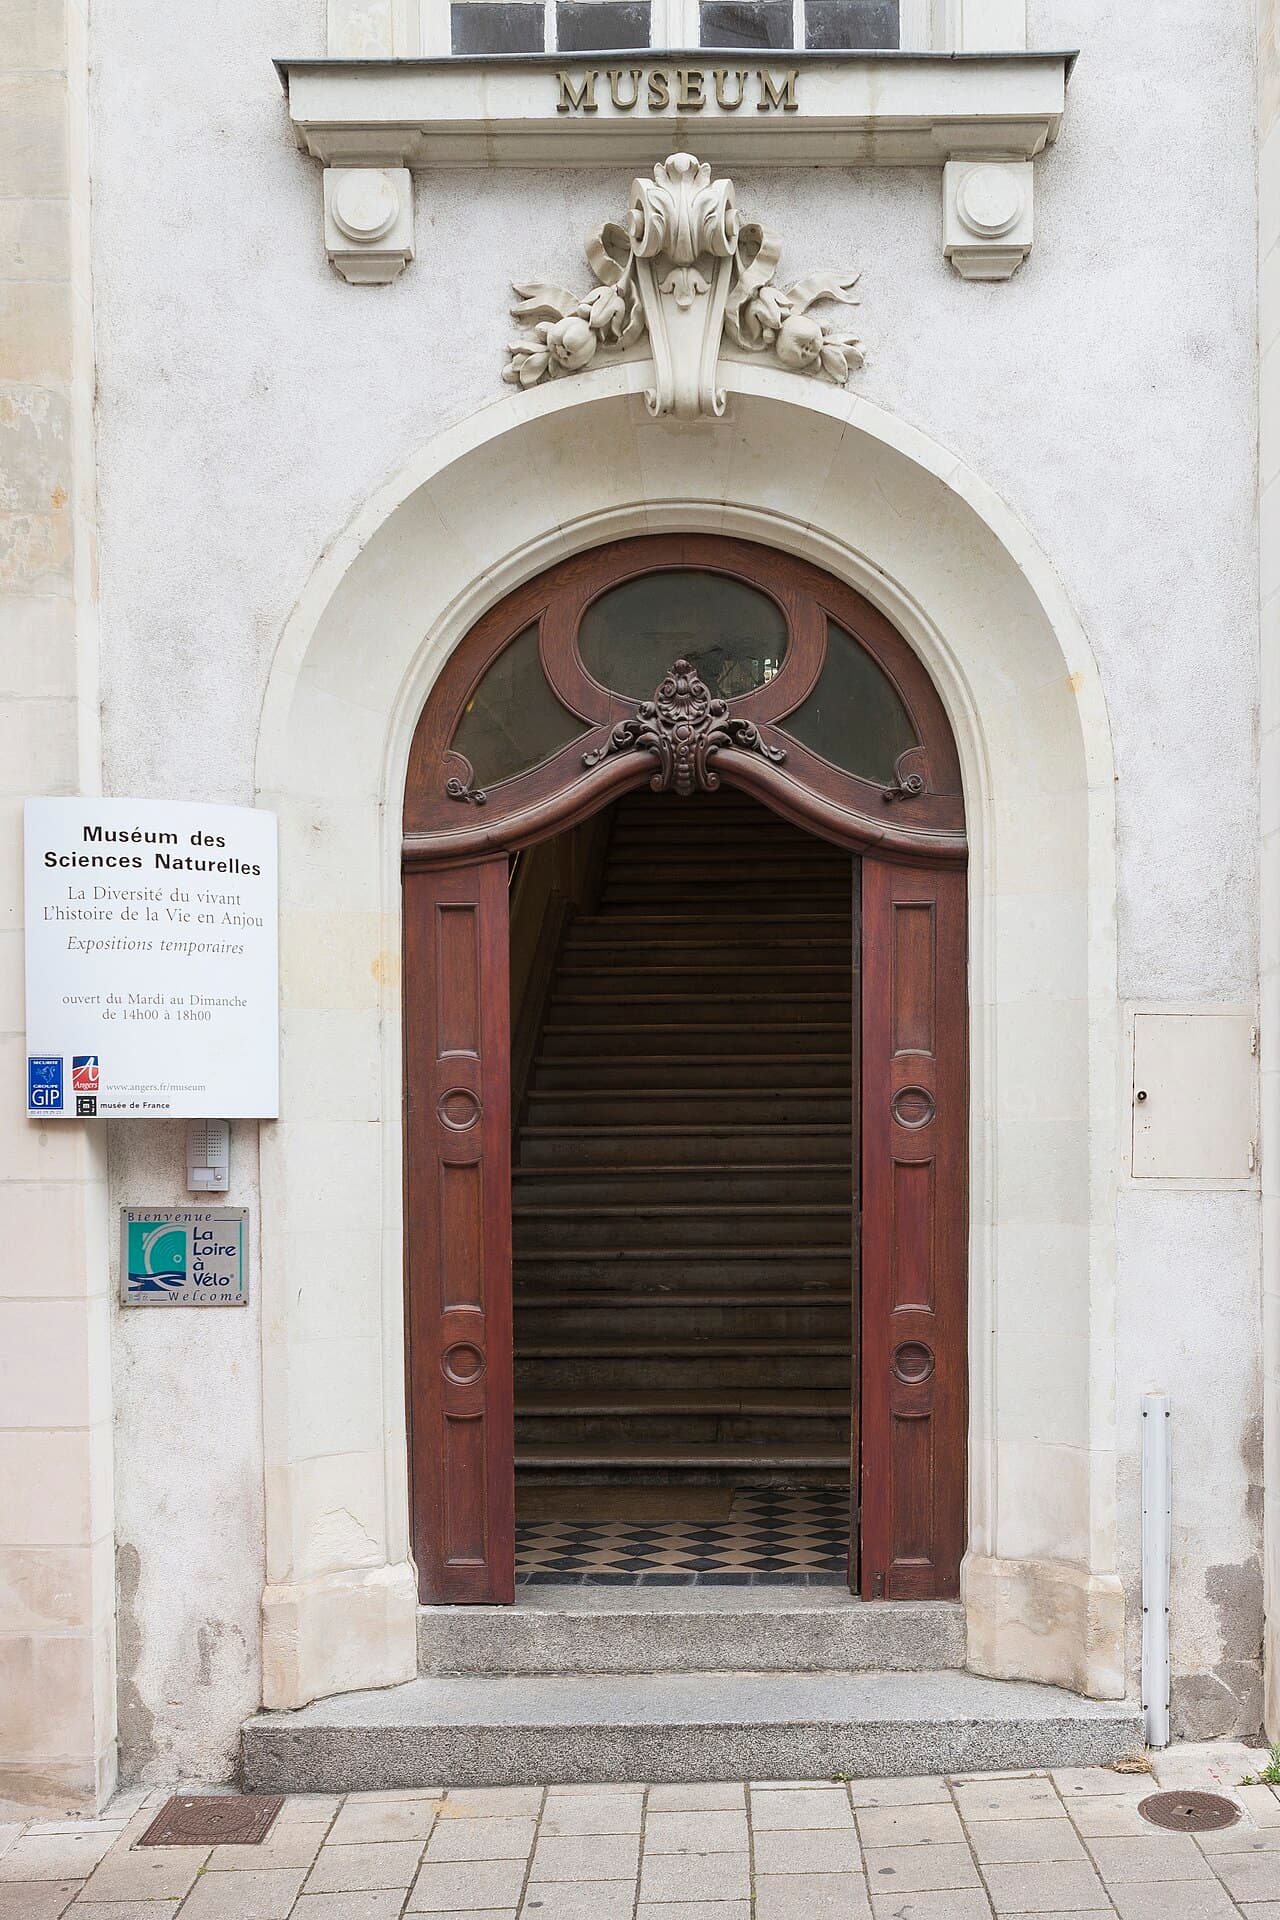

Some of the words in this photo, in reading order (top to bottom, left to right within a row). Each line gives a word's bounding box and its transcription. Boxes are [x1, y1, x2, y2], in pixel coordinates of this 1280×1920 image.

[555, 69, 799, 112] MUSEUM
[83, 826, 178, 844] Muséum
[190, 831, 226, 848] des
[44, 851, 143, 868] Sciences
[155, 853, 261, 876] Naturelles
[68, 886, 85, 900] La
[93, 886, 163, 902] Diversité
[170, 888, 190, 903] du
[197, 889, 241, 906] vivant
[120, 907, 139, 921] de
[146, 907, 159, 922] la
[166, 908, 191, 923] Vie
[197, 912, 215, 925] en
[221, 911, 264, 930] Anjou
[67, 936, 153, 954] Expositions
[160, 937, 244, 956] temporaires
[62, 994, 101, 1006] ouvert
[106, 993, 122, 1005] du
[128, 993, 165, 1006] Mardi
[170, 996, 184, 1006] au
[190, 994, 248, 1007] Dimanche
[102, 1008, 117, 1020] de
[122, 1008, 159, 1021] 14h00
[164, 1010, 171, 1021] à
[176, 1009, 212, 1022] 18h00
[106, 1082, 206, 1093] www.angers.fr/museum
[32, 1089, 60, 1106] GIP
[100, 1101, 127, 1109] musée
[129, 1101, 140, 1109] de
[143, 1101, 170, 1109] France
[128, 1212, 212, 1222] Bienvenue
[193, 1226, 213, 1240] La
[193, 1242, 236, 1256] Loire
[193, 1257, 205, 1271] à
[193, 1272, 230, 1287] Vélo
[168, 1290, 242, 1301] Welcome
